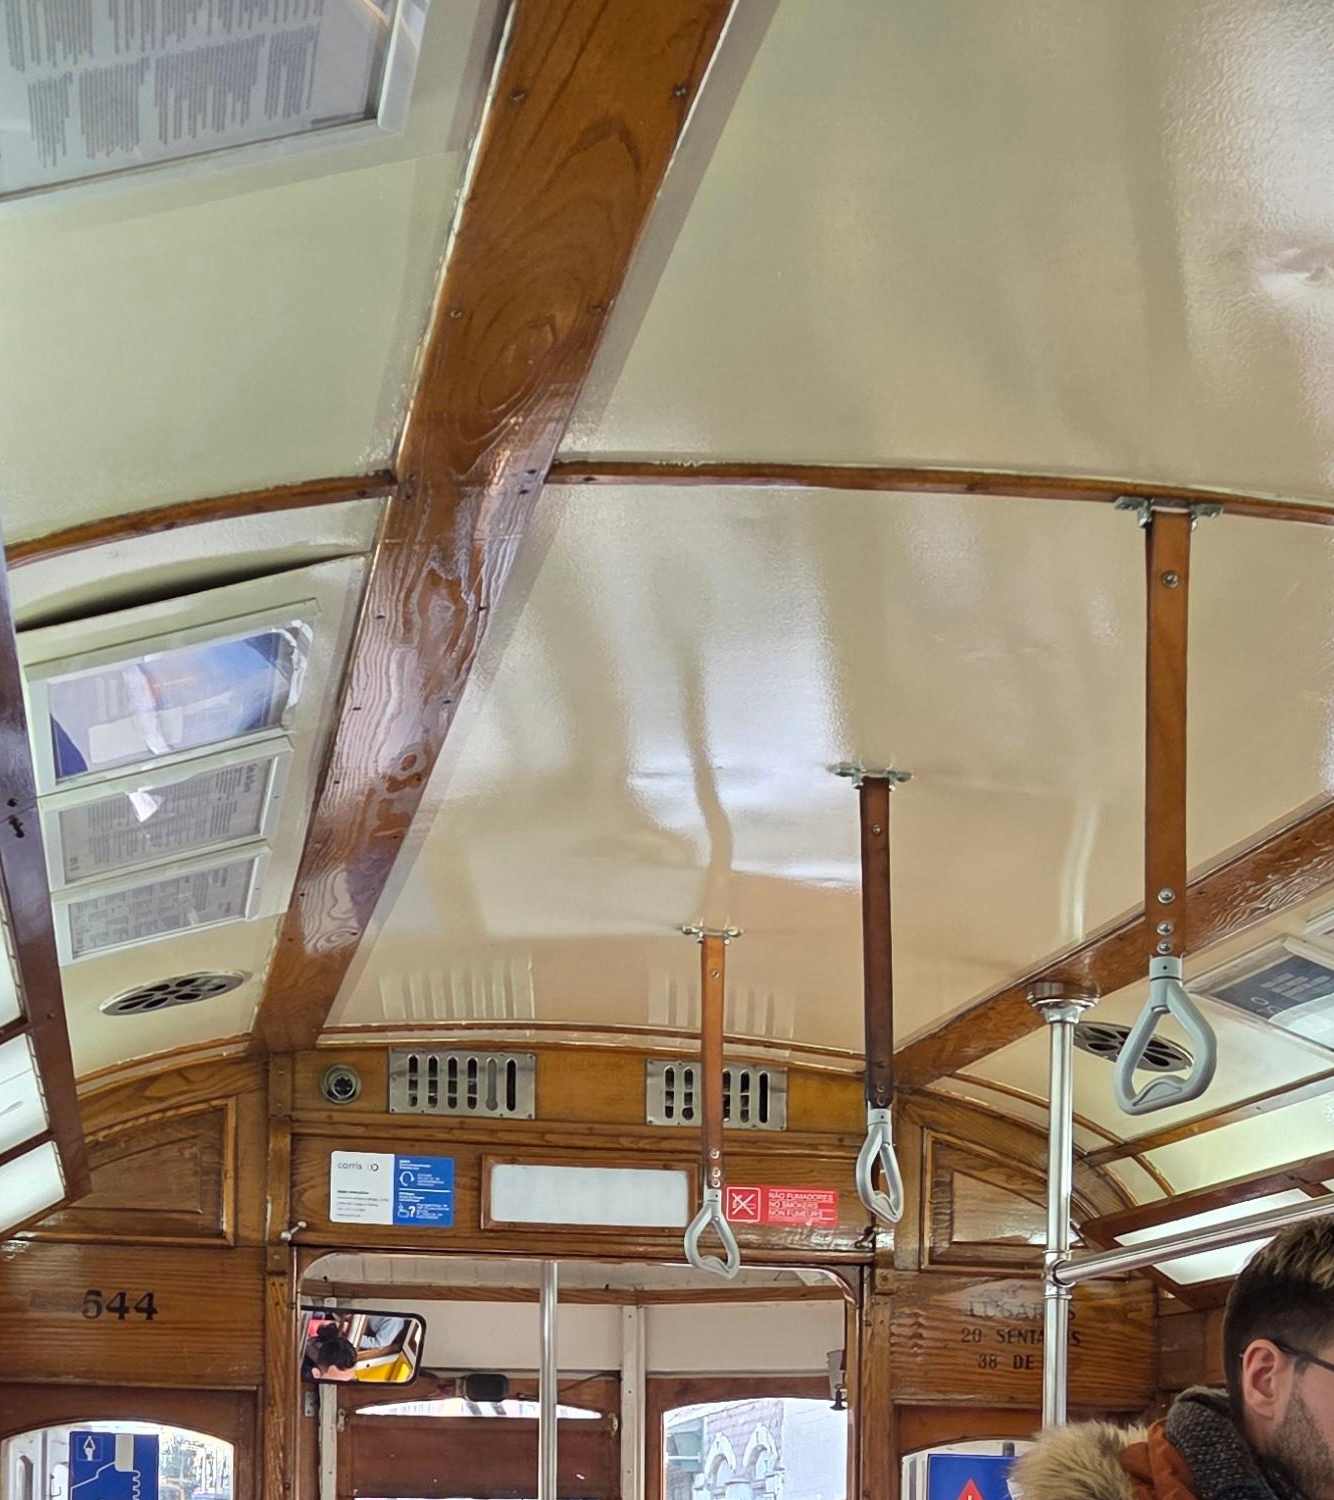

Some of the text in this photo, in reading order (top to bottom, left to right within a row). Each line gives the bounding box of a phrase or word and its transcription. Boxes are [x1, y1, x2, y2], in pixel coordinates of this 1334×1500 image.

[769, 1191, 785, 1200] NÃO
[82, 1290, 158, 1320] 544
[961, 1328, 983, 1343] 20
[1013, 1354, 1035, 1370] DE
